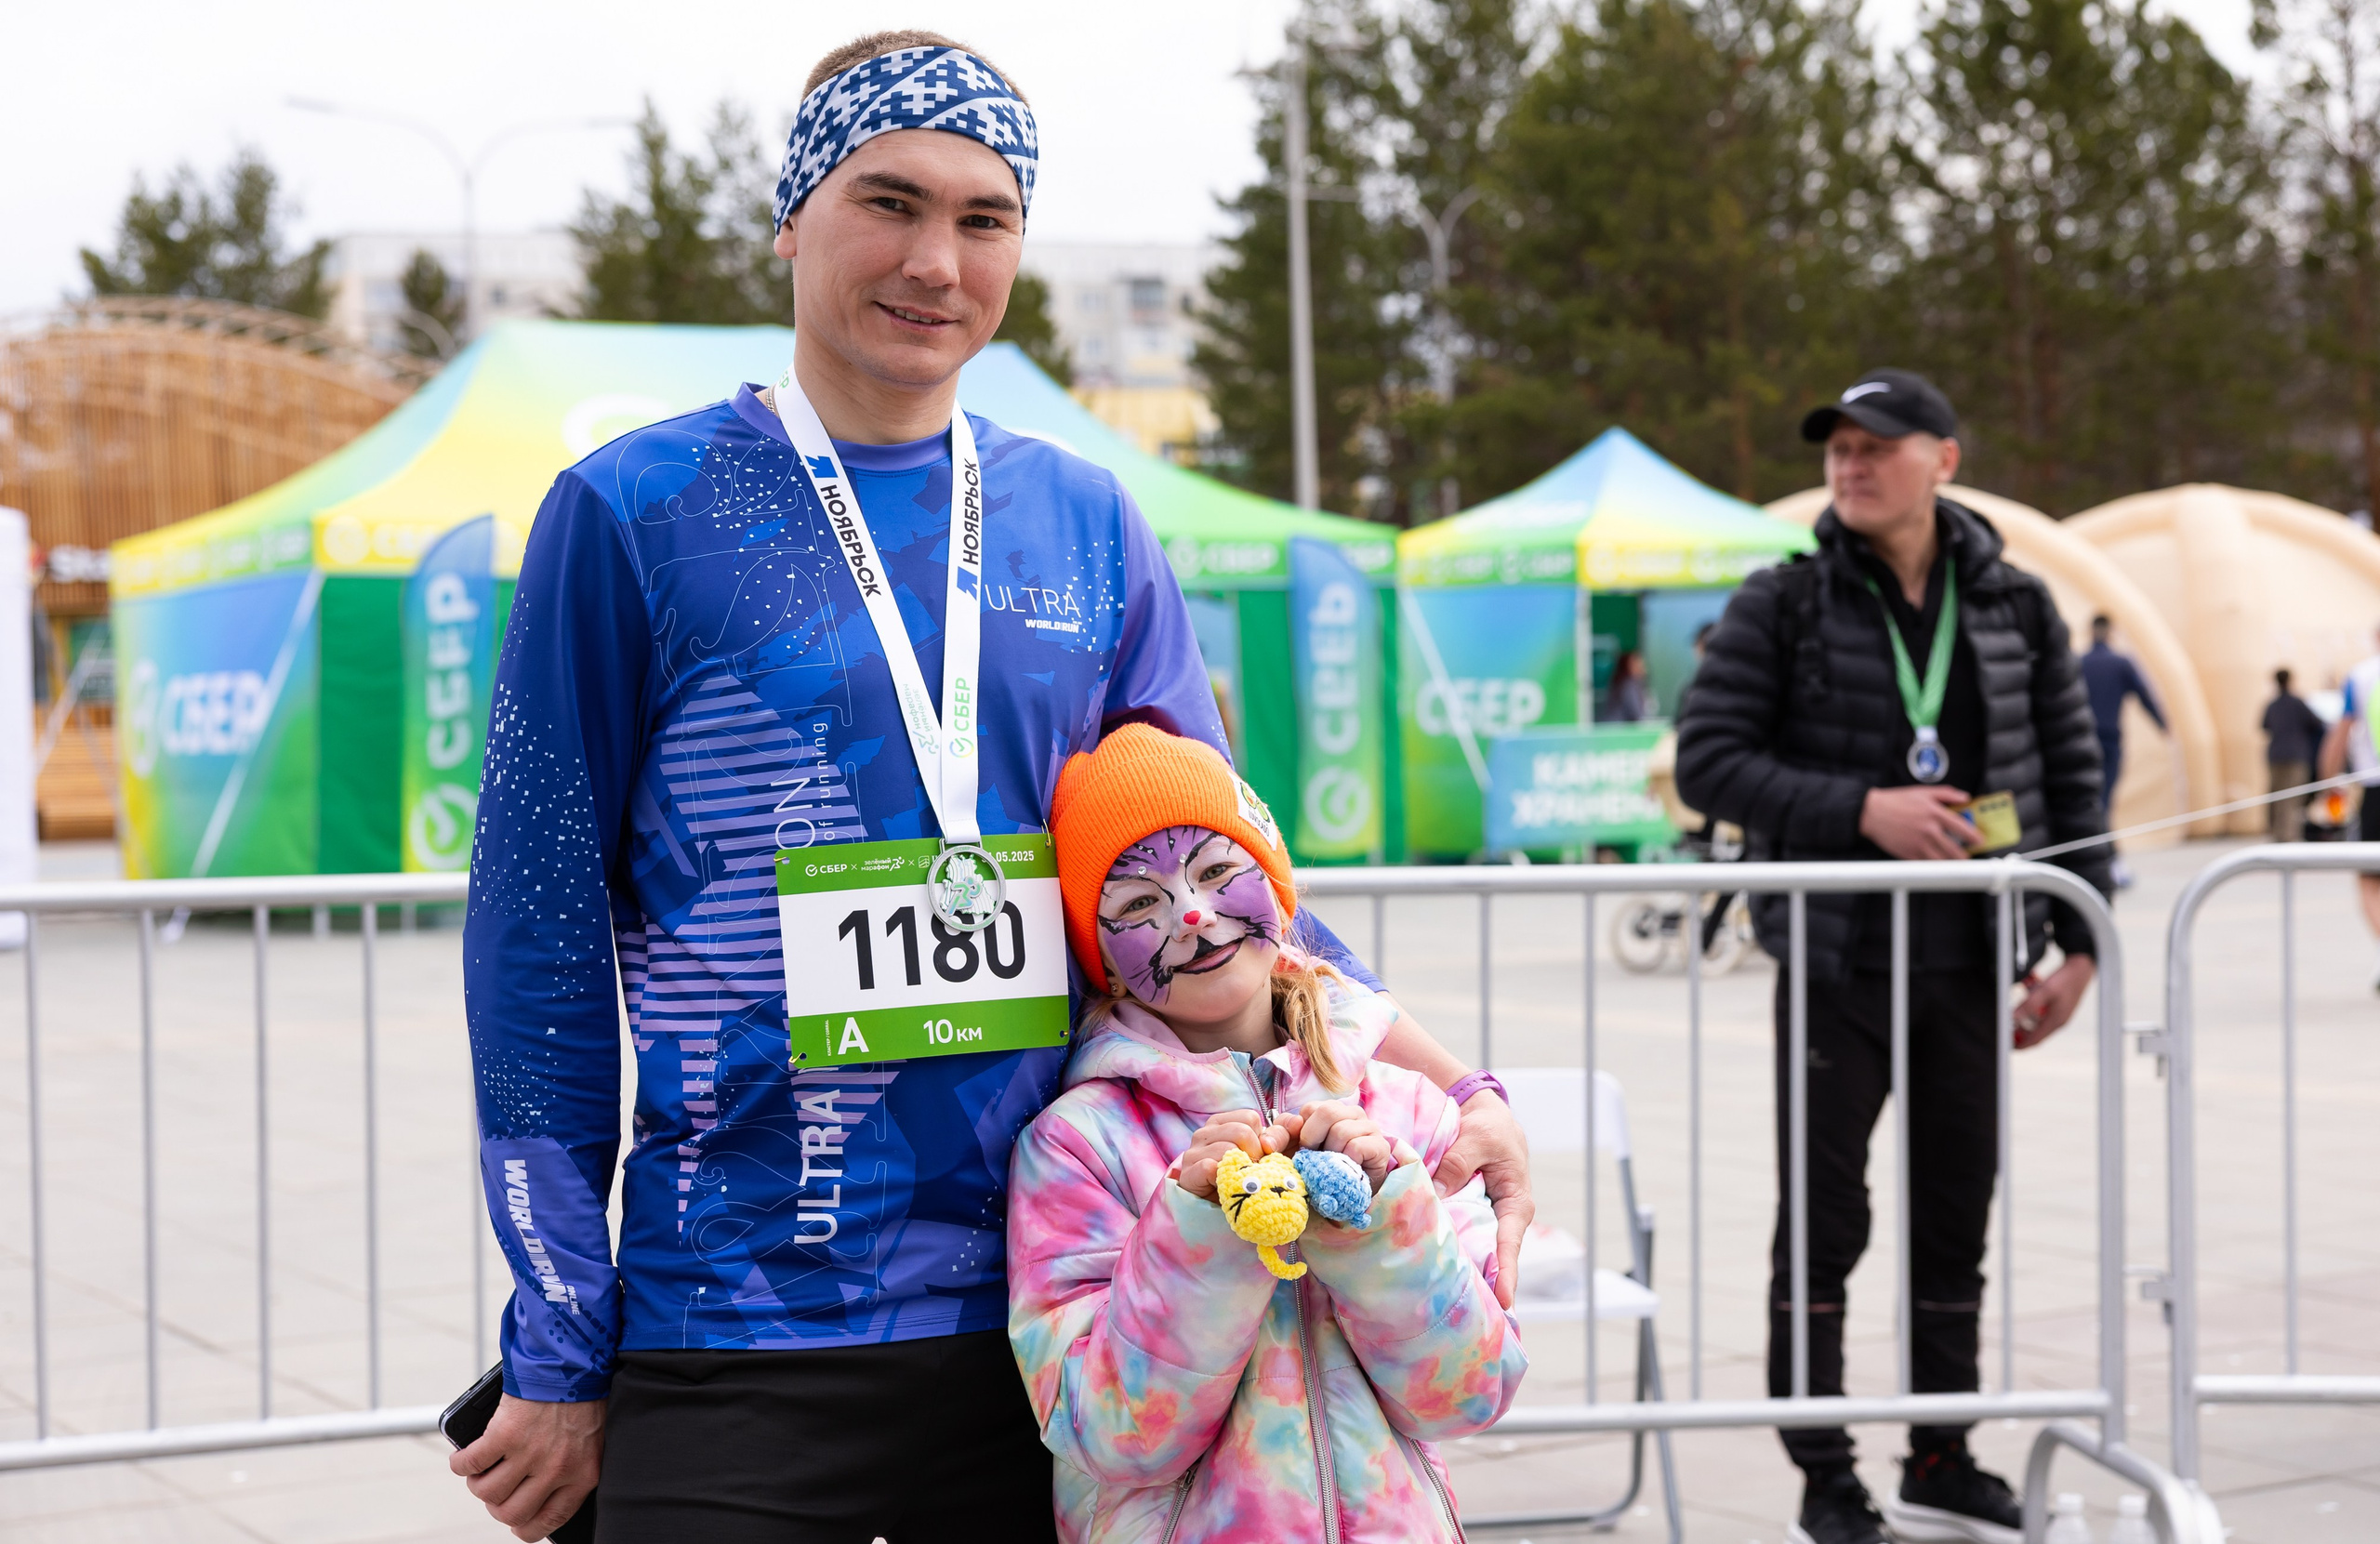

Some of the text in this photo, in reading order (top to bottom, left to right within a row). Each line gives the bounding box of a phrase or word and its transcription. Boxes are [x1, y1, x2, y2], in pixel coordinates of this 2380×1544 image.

[820, 484, 881, 598] НОЯБРЬСК
[962, 457, 979, 565] НОЯБРЬСК
[985, 584, 1081, 618] ULTRA
[954, 677, 971, 732] СБЕР
[1310, 583, 1359, 755] СБЕР
[903, 683, 921, 730] марафон
[812, 722, 835, 840] of running
[820, 864, 848, 874] СБЕР
[838, 900, 1025, 990] 1180
[923, 1019, 953, 1045] 10
[794, 1089, 843, 1244] ULTRA
[566, 1285, 580, 1315] ONLINE
